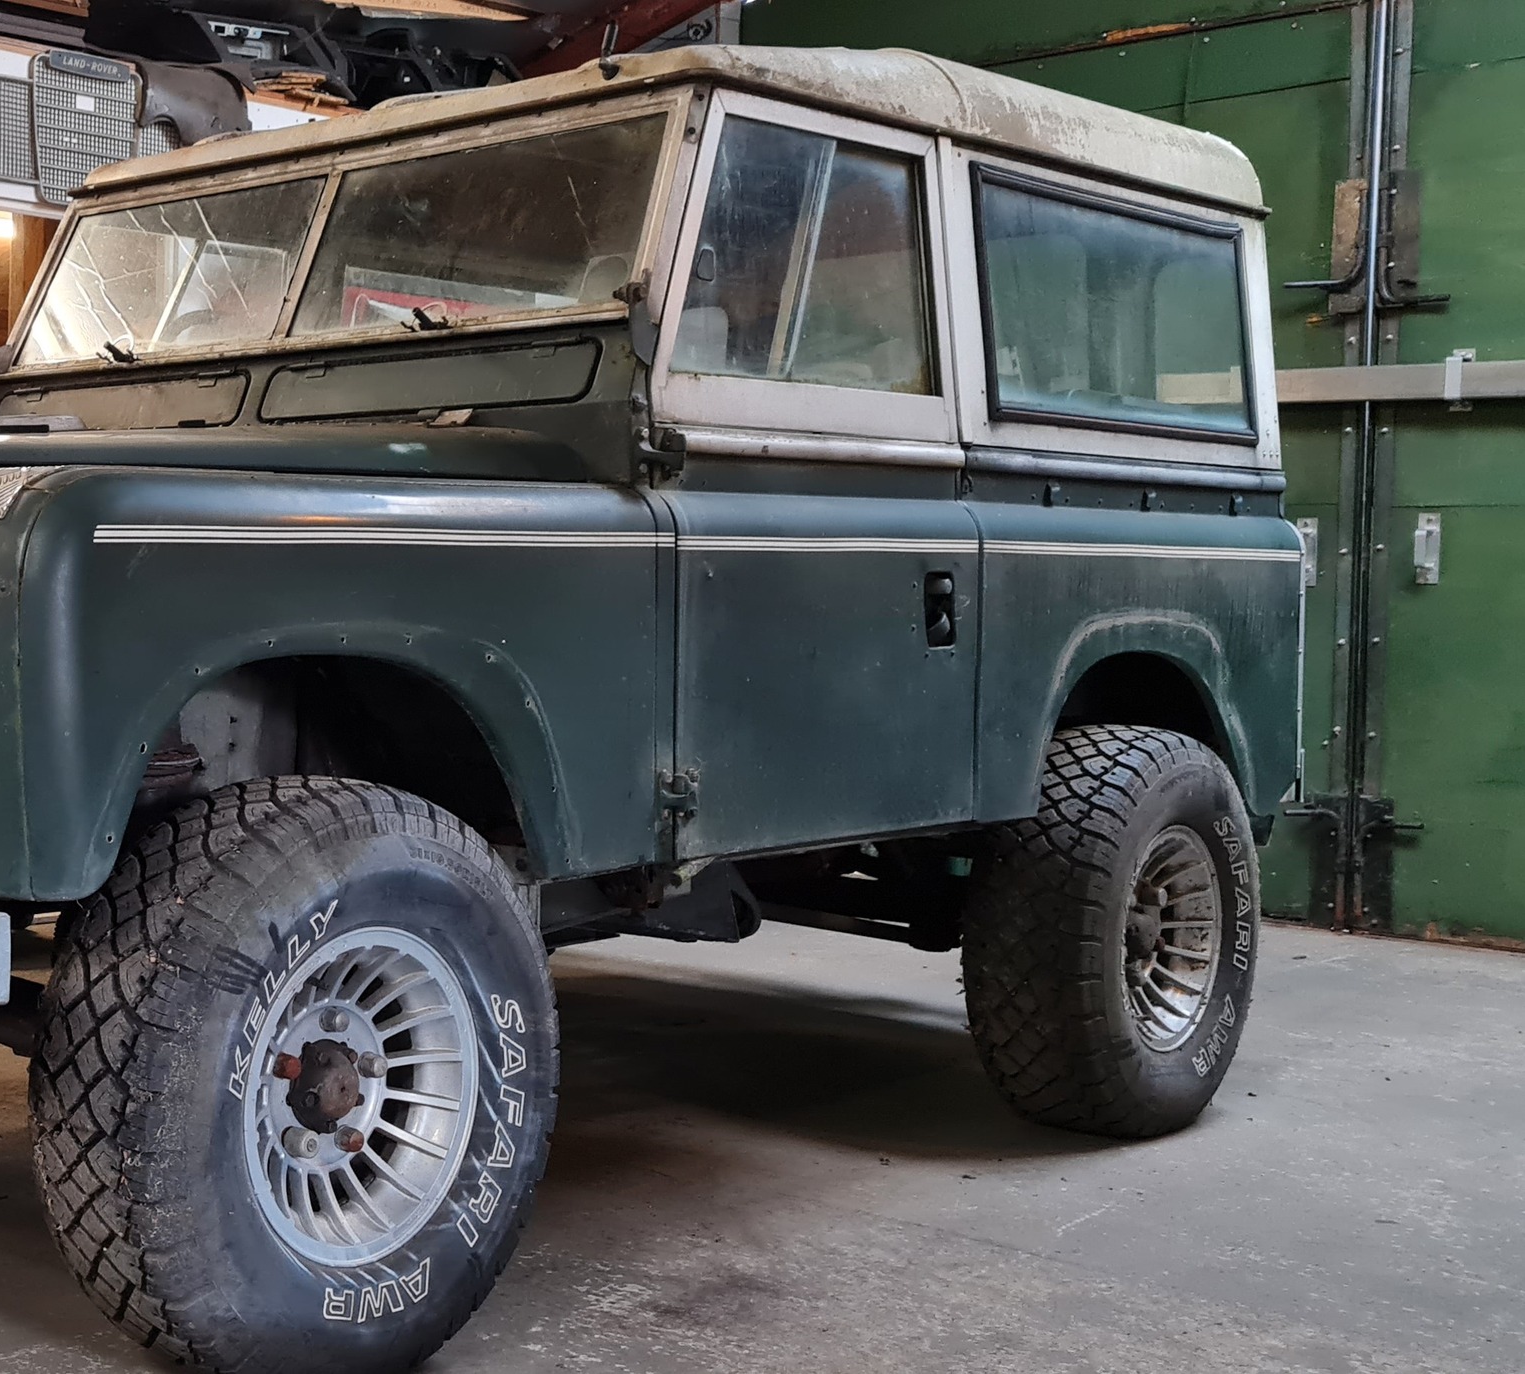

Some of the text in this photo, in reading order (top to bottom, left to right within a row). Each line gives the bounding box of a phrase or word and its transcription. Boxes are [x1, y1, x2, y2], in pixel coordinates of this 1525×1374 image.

[226, 899, 340, 1101] KELLY
[1192, 816, 1253, 1078] SAFARI AWR
[322, 993, 529, 1324] SAFARI AWR
